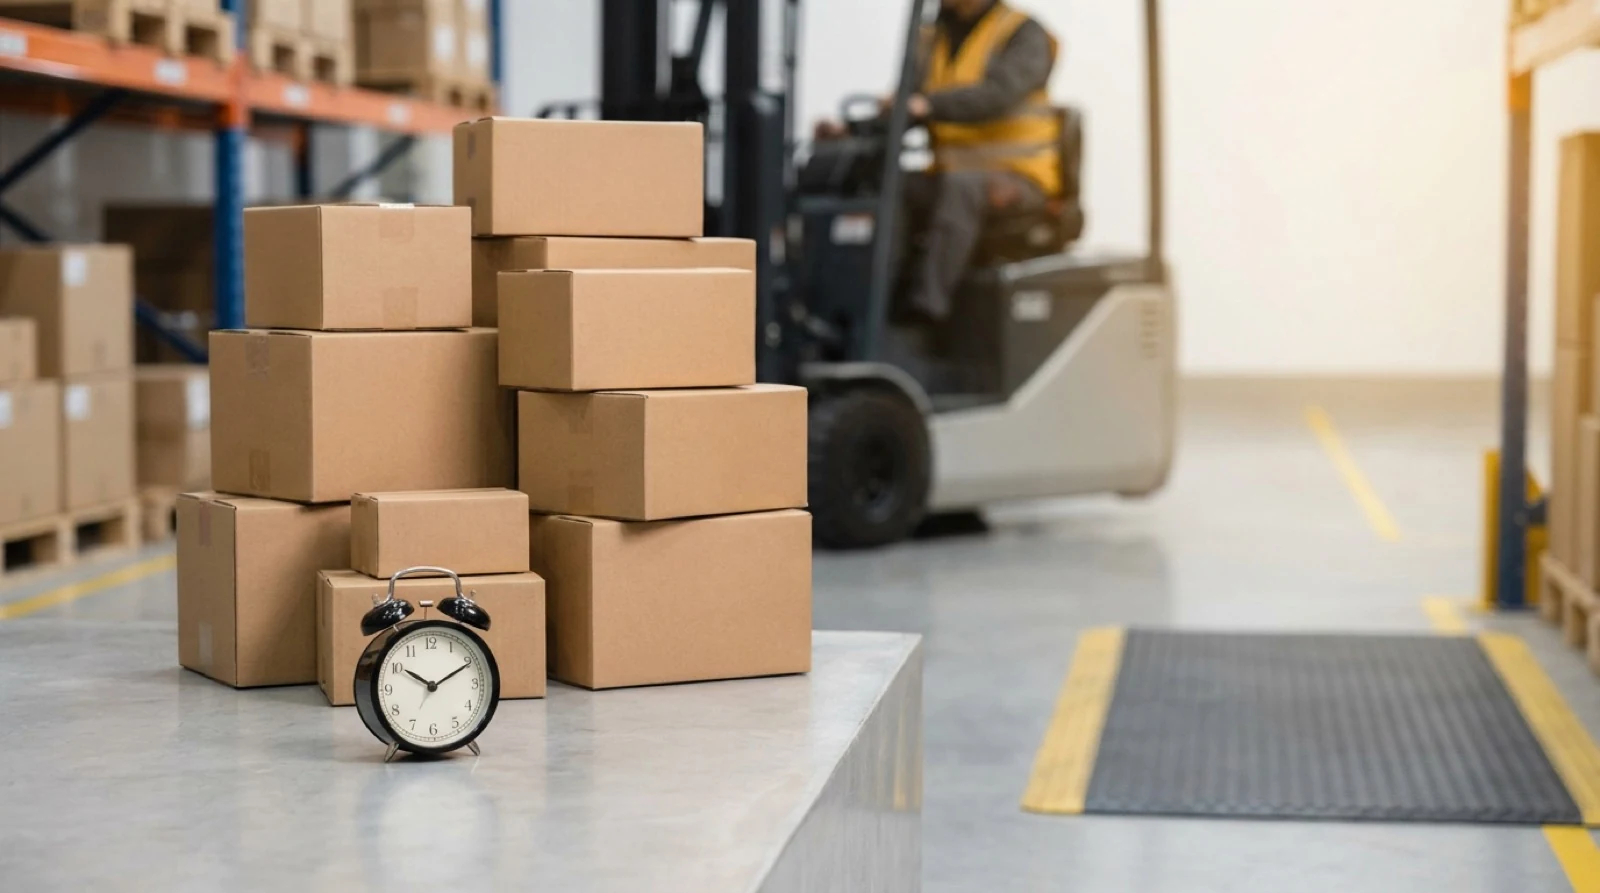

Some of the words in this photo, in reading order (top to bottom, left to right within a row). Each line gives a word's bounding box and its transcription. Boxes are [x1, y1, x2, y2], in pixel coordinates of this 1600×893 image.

[426, 637, 437, 649] 12
[449, 641, 453, 653] 1
[406, 645, 416, 658] 11
[392, 662, 403, 674] 10
[472, 678, 479, 690] 3
[385, 685, 392, 696] 9
[392, 704, 400, 716] 8
[464, 700, 472, 711] 4
[409, 720, 416, 730] 7
[452, 717, 459, 729] 5
[429, 724, 438, 735] 6
